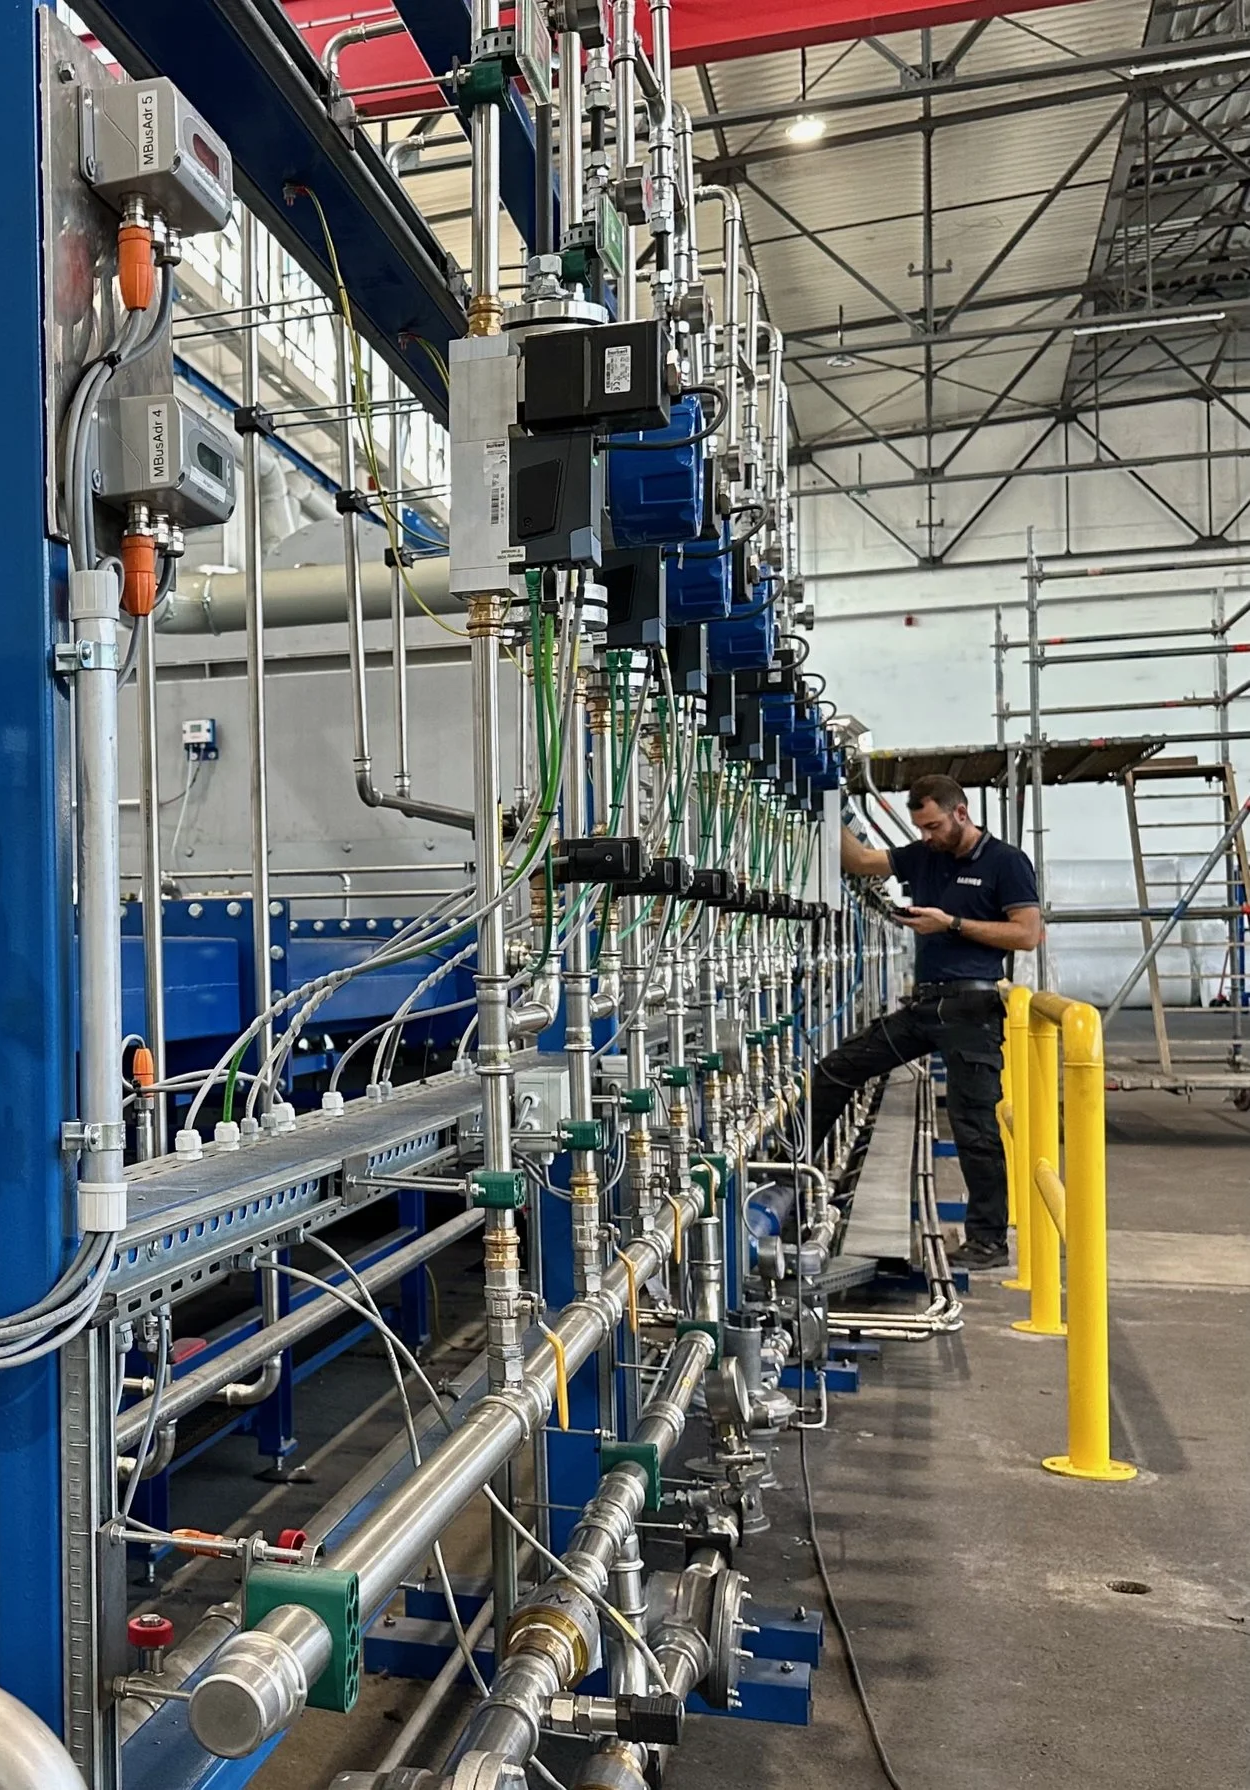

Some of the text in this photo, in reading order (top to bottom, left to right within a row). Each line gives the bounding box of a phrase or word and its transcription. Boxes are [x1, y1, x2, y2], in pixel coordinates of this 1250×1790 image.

[142, 95, 155, 166] MBusAdr 5
[152, 409, 164, 478] MBusAdr 4
